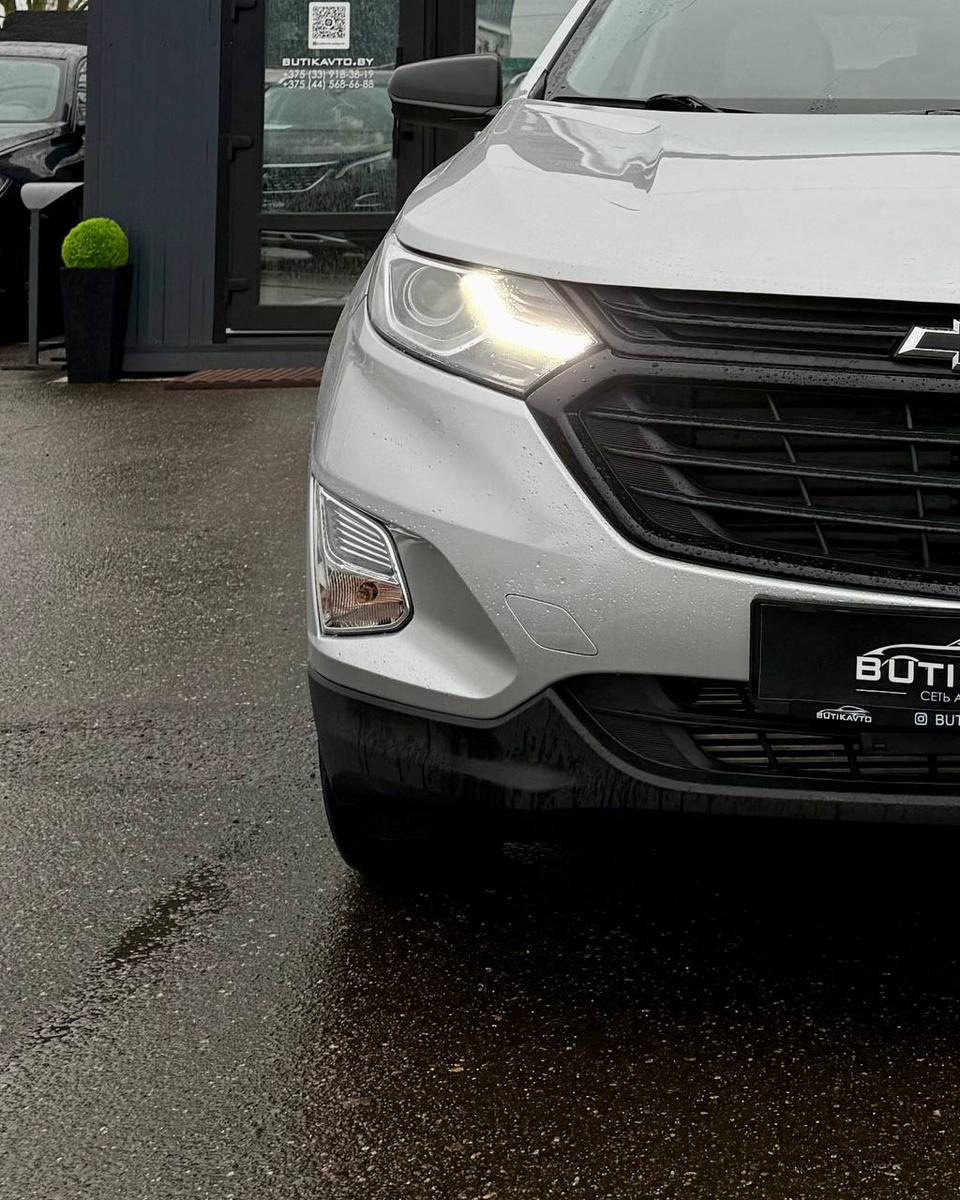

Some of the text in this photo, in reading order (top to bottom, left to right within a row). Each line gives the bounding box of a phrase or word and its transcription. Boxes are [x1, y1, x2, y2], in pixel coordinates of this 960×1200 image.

[282, 58, 375, 66] BUTIKAVTO.BY
[283, 70, 306, 79] +375
[308, 69, 326, 80] (33)
[283, 80, 306, 89] +375
[308, 79, 326, 90] (44)
[920, 691, 951, 703] СЕТЬ
[816, 712, 872, 723] BUTIKAVTO
